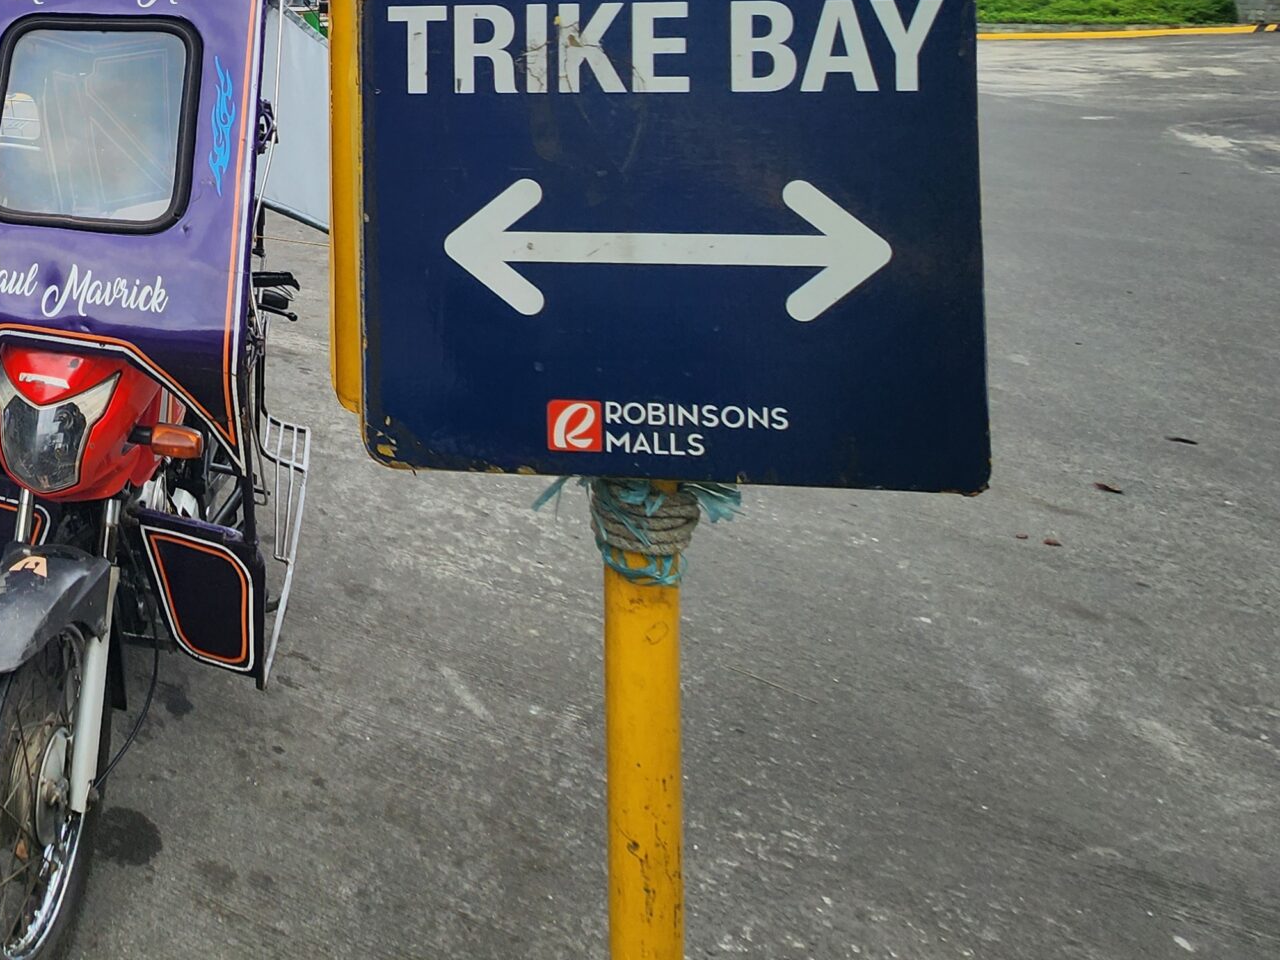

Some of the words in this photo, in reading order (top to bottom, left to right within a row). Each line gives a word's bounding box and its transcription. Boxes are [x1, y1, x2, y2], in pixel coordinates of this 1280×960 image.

[387, 3, 690, 95] TRIKE
[40, 263, 169, 317] Mavrick
[604, 400, 789, 431] ROBINSONS
[604, 431, 706, 457] MALLS
